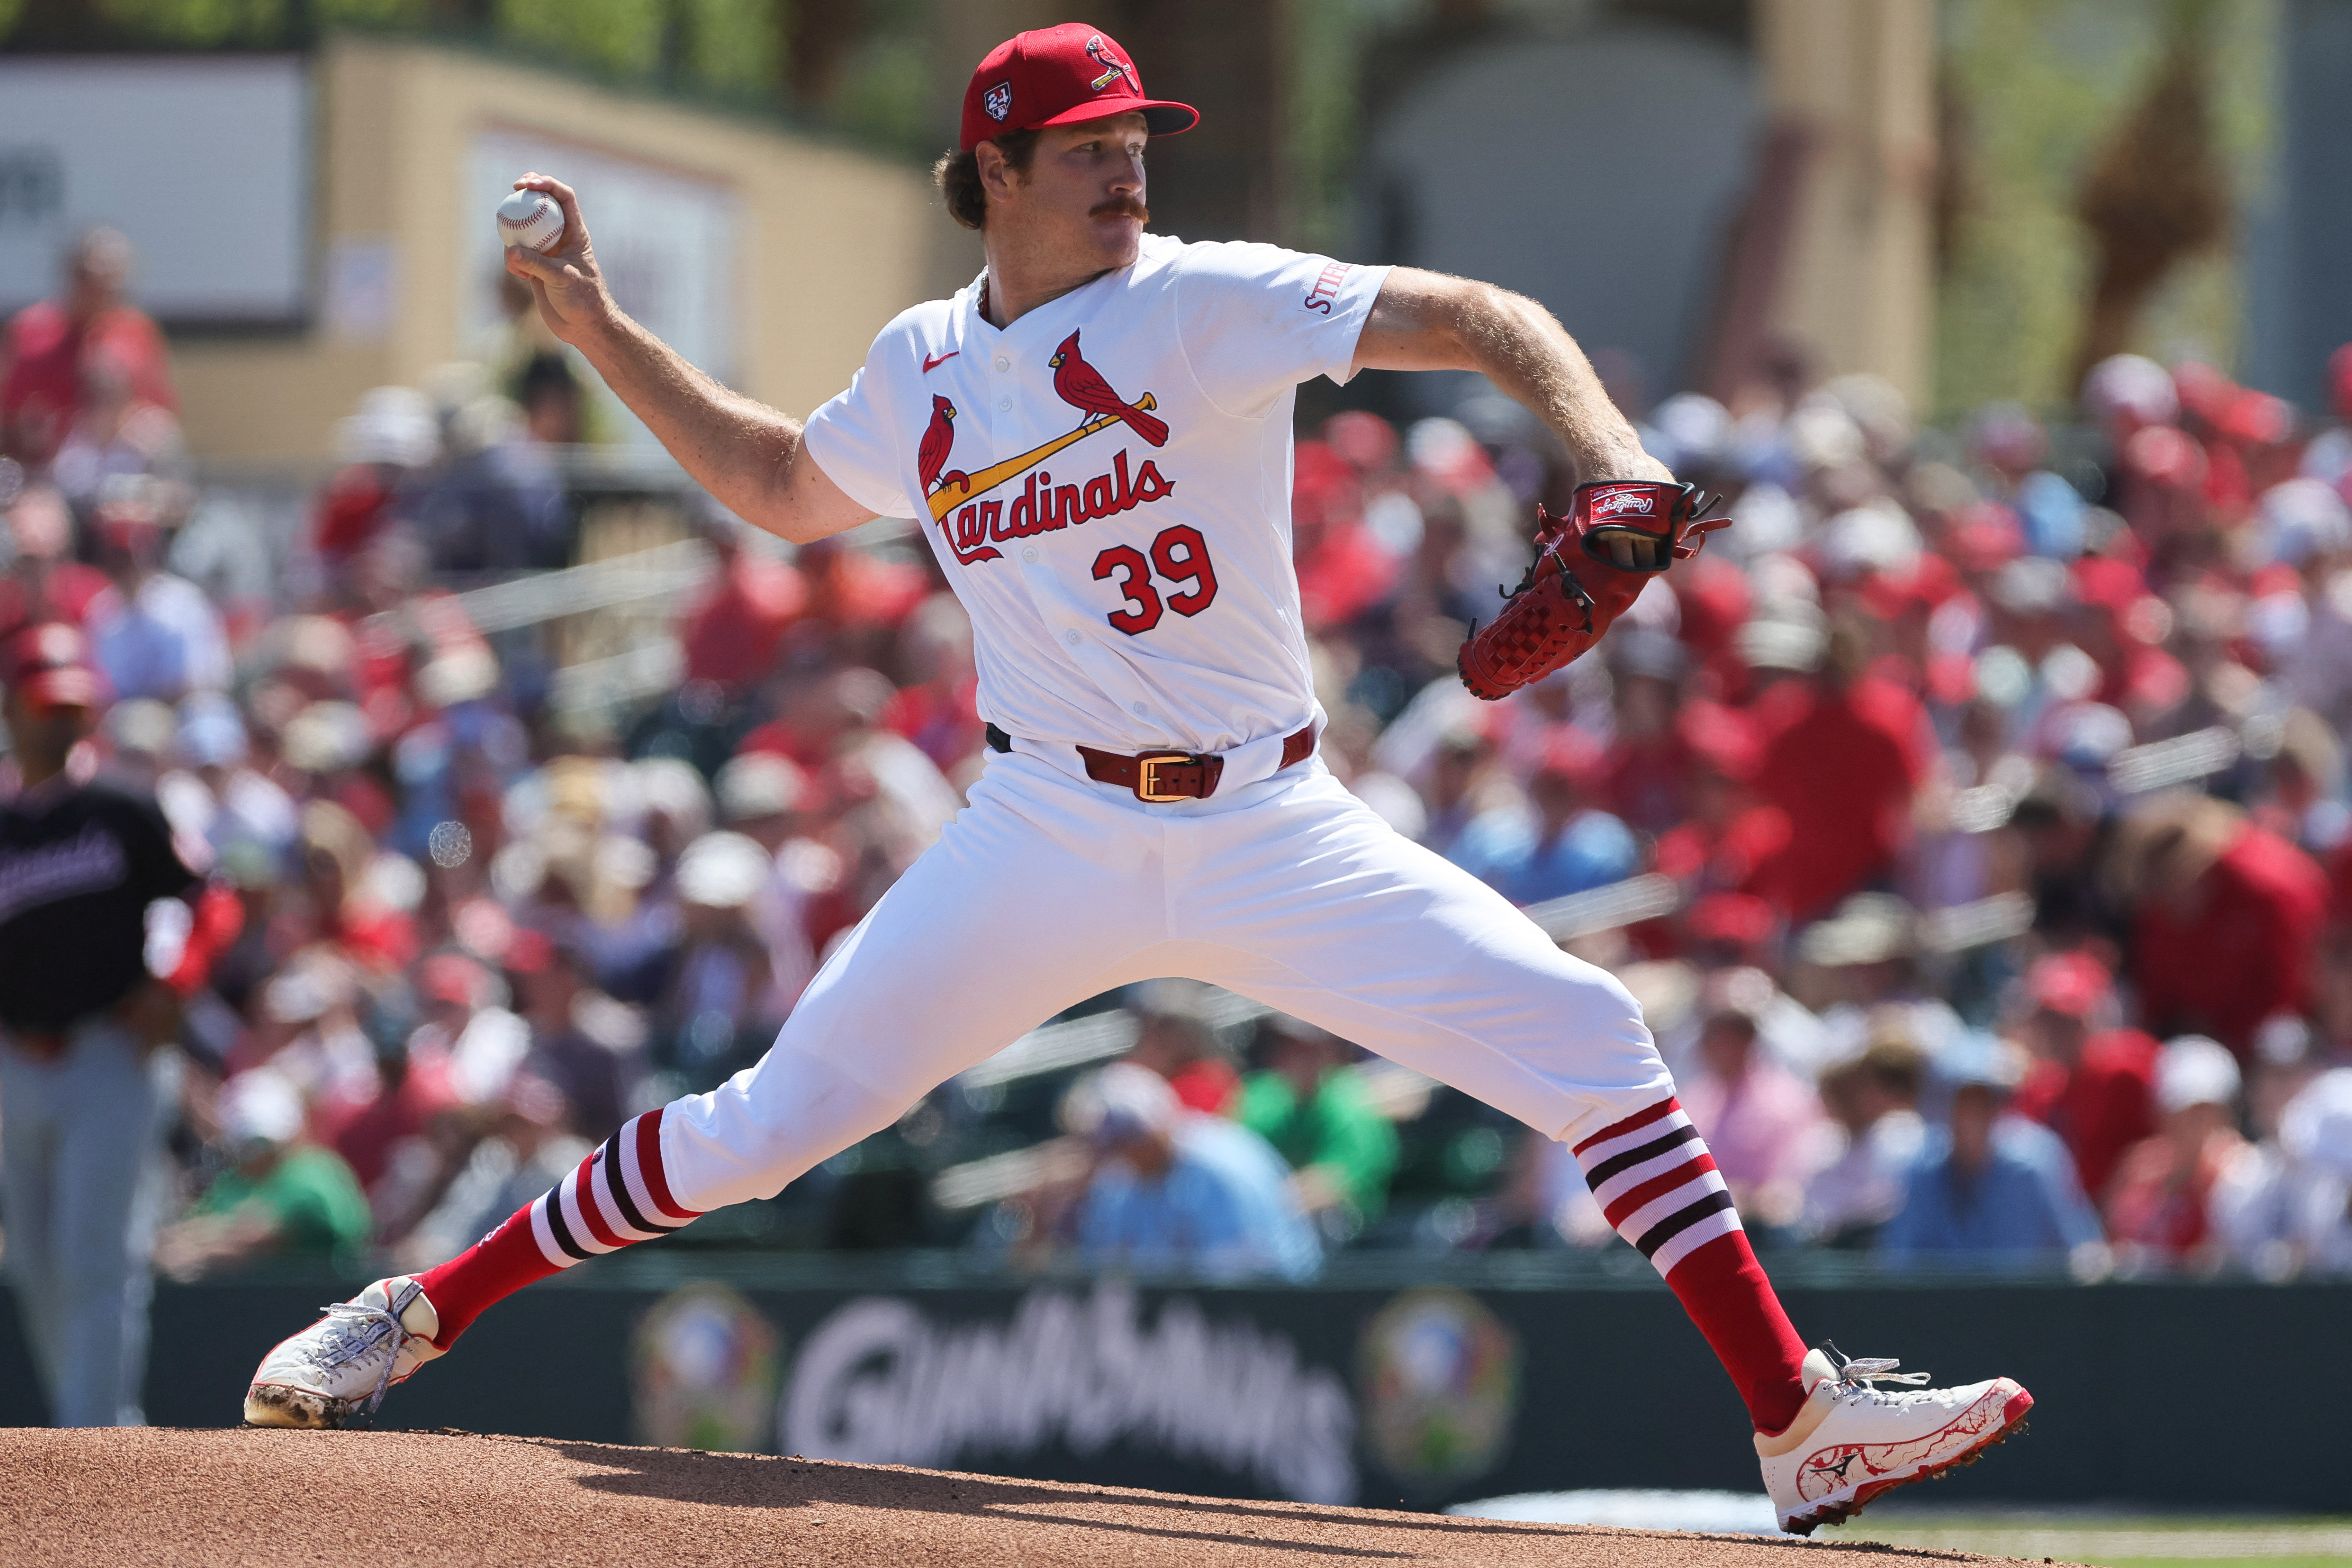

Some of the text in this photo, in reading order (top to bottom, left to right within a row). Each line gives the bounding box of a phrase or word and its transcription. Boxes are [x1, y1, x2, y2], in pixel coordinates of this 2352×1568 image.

[940, 447, 1177, 566] Cardinals
[1596, 497, 1653, 514] Rawlings
[1091, 524, 1219, 637] 39
